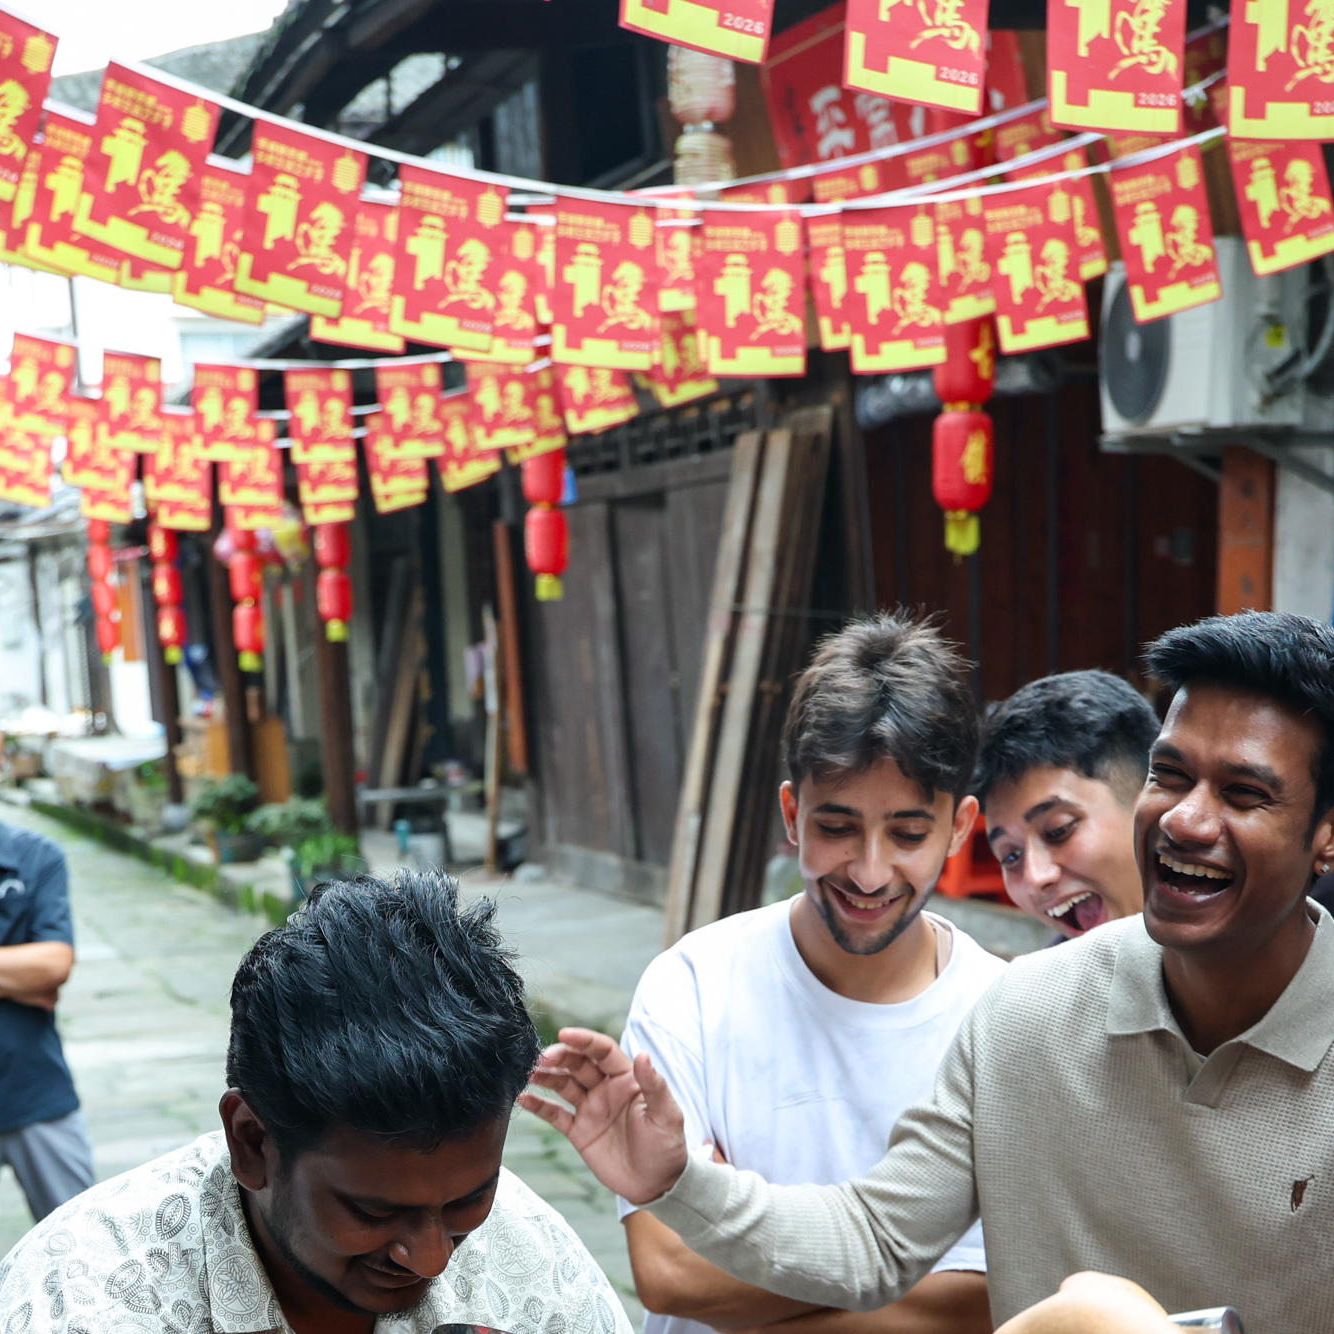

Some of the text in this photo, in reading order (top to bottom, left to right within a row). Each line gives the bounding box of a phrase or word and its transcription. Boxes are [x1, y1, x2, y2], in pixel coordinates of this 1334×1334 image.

[723, 13, 765, 35] 2026
[940, 66, 979, 85] 2026
[1138, 92, 1178, 106] 2026
